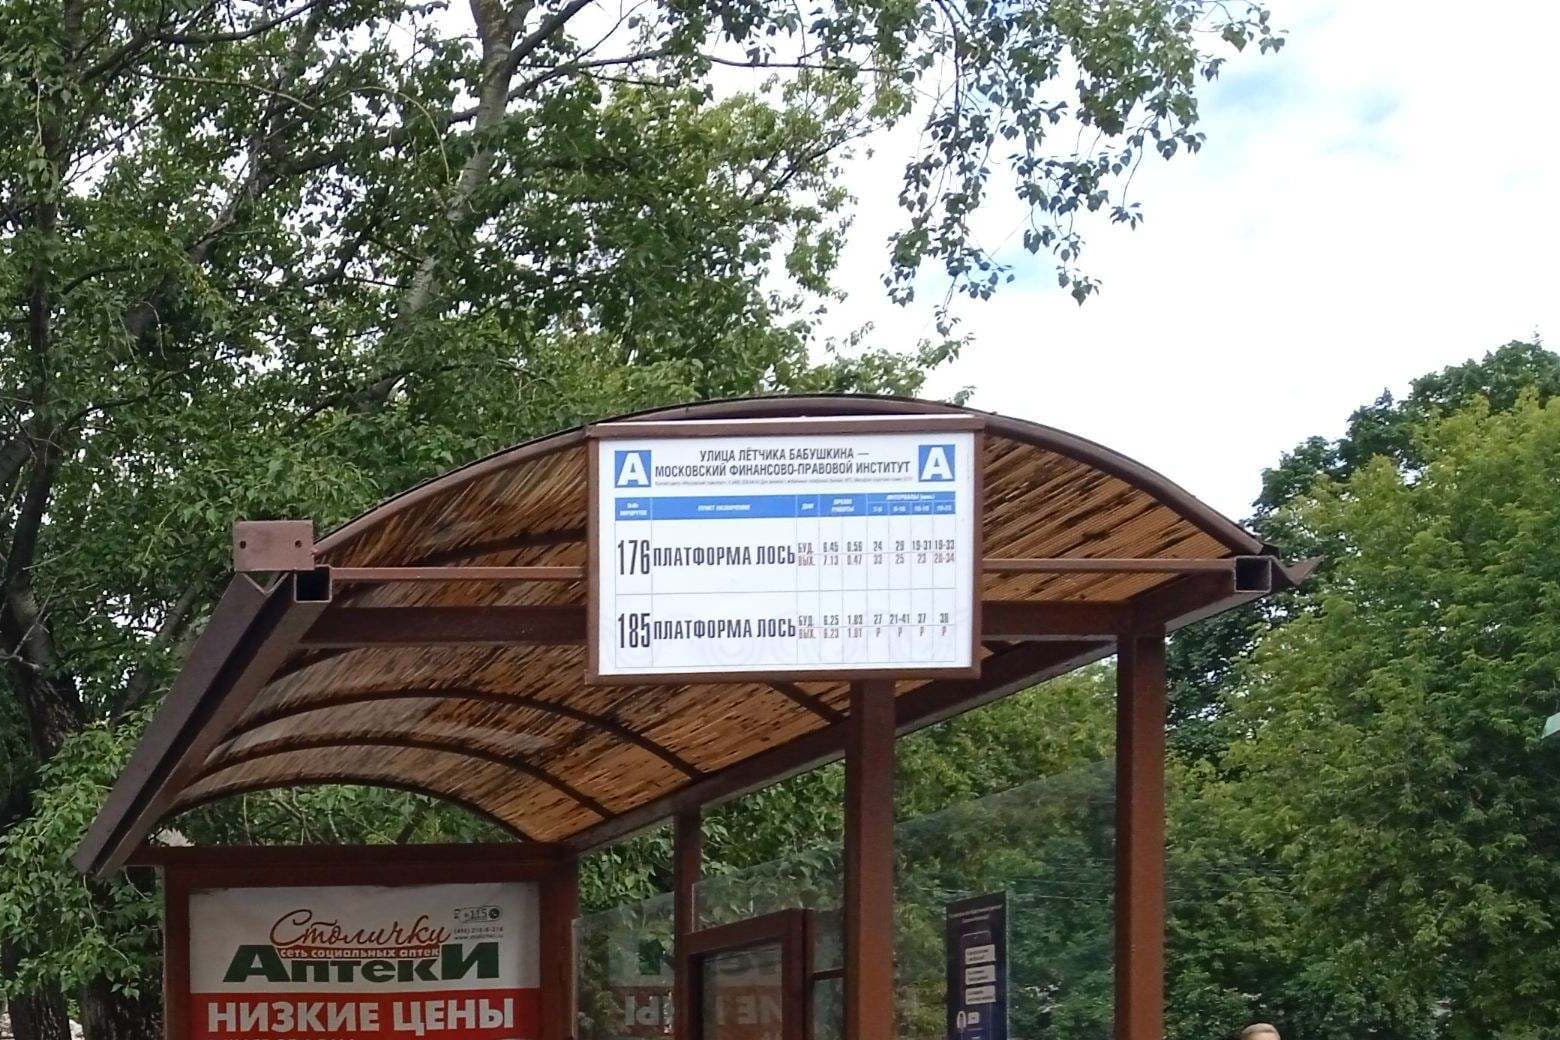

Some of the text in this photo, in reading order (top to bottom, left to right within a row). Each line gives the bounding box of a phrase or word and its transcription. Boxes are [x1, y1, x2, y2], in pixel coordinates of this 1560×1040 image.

[617, 452, 649, 486] А
[655, 461, 911, 477] МОСКОВСКИЙ ФИНАНСОВО-ПРАВОВОЙ ИНСТИТУТ
[700, 450, 735, 463] УЛИЦА
[738, 446, 786, 462] ЛЁТЧИКА
[789, 448, 854, 461] БАБУШКИНА
[920, 447, 953, 480] А
[617, 539, 650, 575] 176
[653, 545, 796, 567] ПЛАТФОРМА ЛОСЬ
[617, 613, 651, 648] 185
[653, 618, 796, 640] ПЛАТФОРМА ЛОСЬ
[269, 909, 452, 947] Столички
[281, 947, 440, 960] сеть социальных аптек
[208, 998, 514, 1036] НИЗКИЕ ЦЕНЫ
